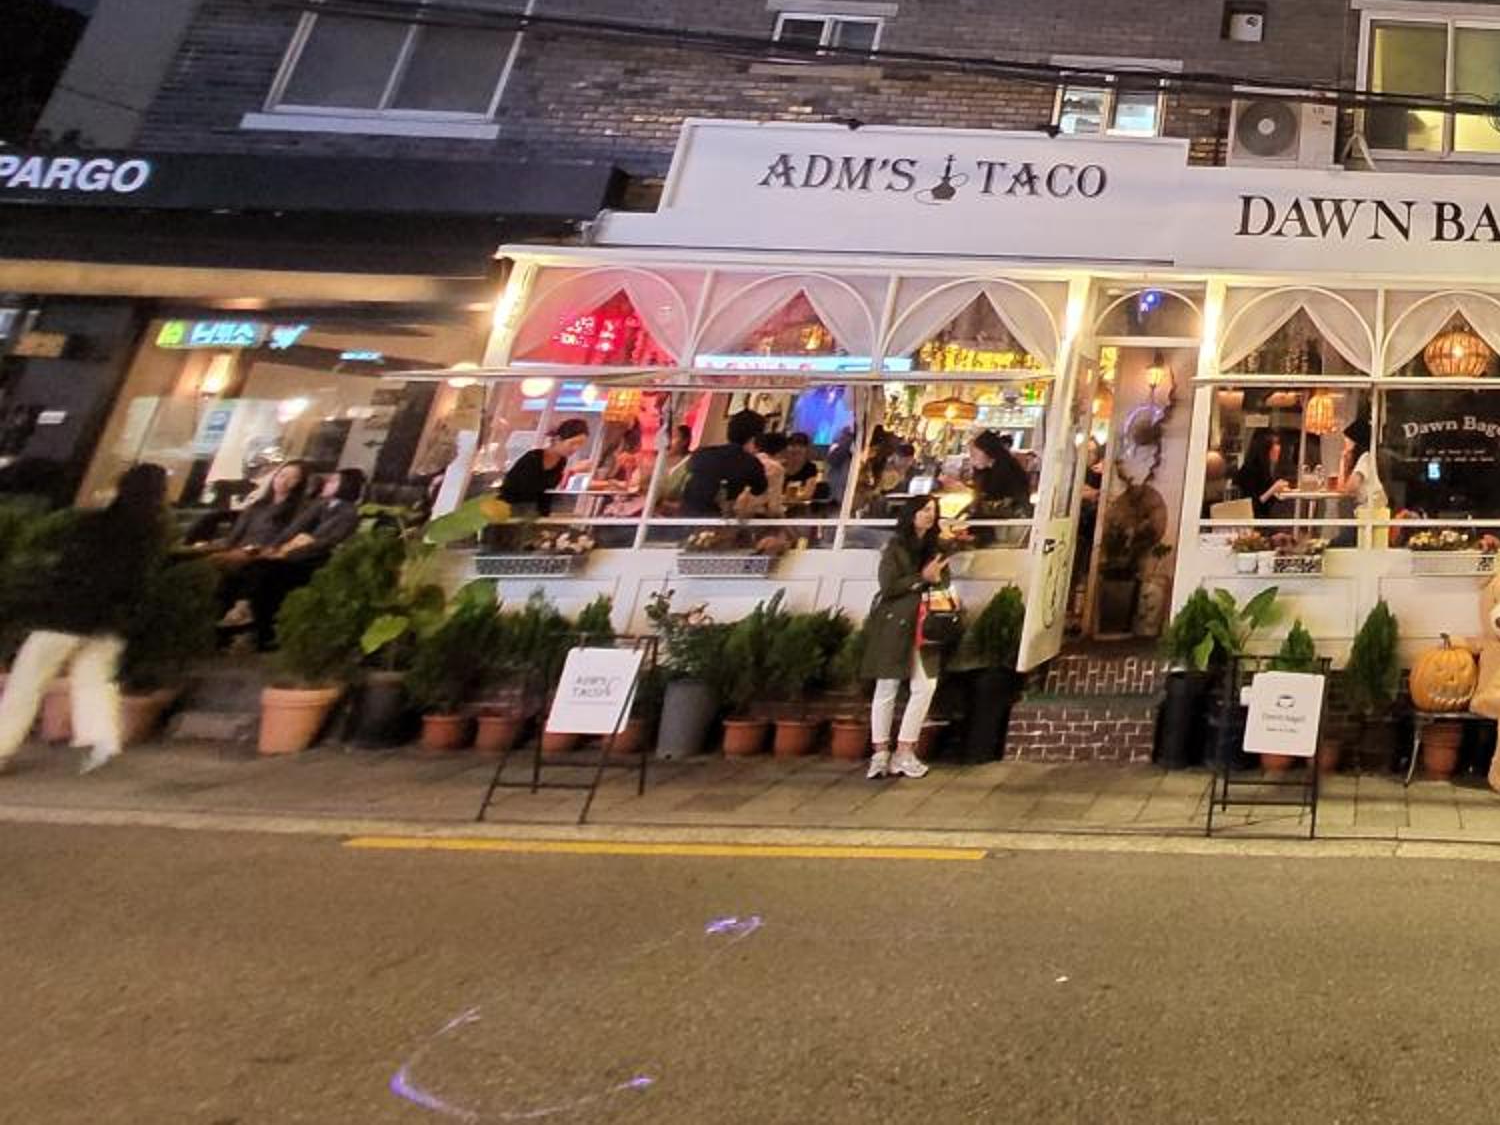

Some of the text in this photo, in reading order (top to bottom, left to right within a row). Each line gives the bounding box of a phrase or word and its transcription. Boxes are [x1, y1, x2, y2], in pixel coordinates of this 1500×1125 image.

[759, 153, 1108, 198] ADM'S TACO
[1235, 195, 1417, 241] DAWN
[1402, 420, 1458, 439] Dawn
